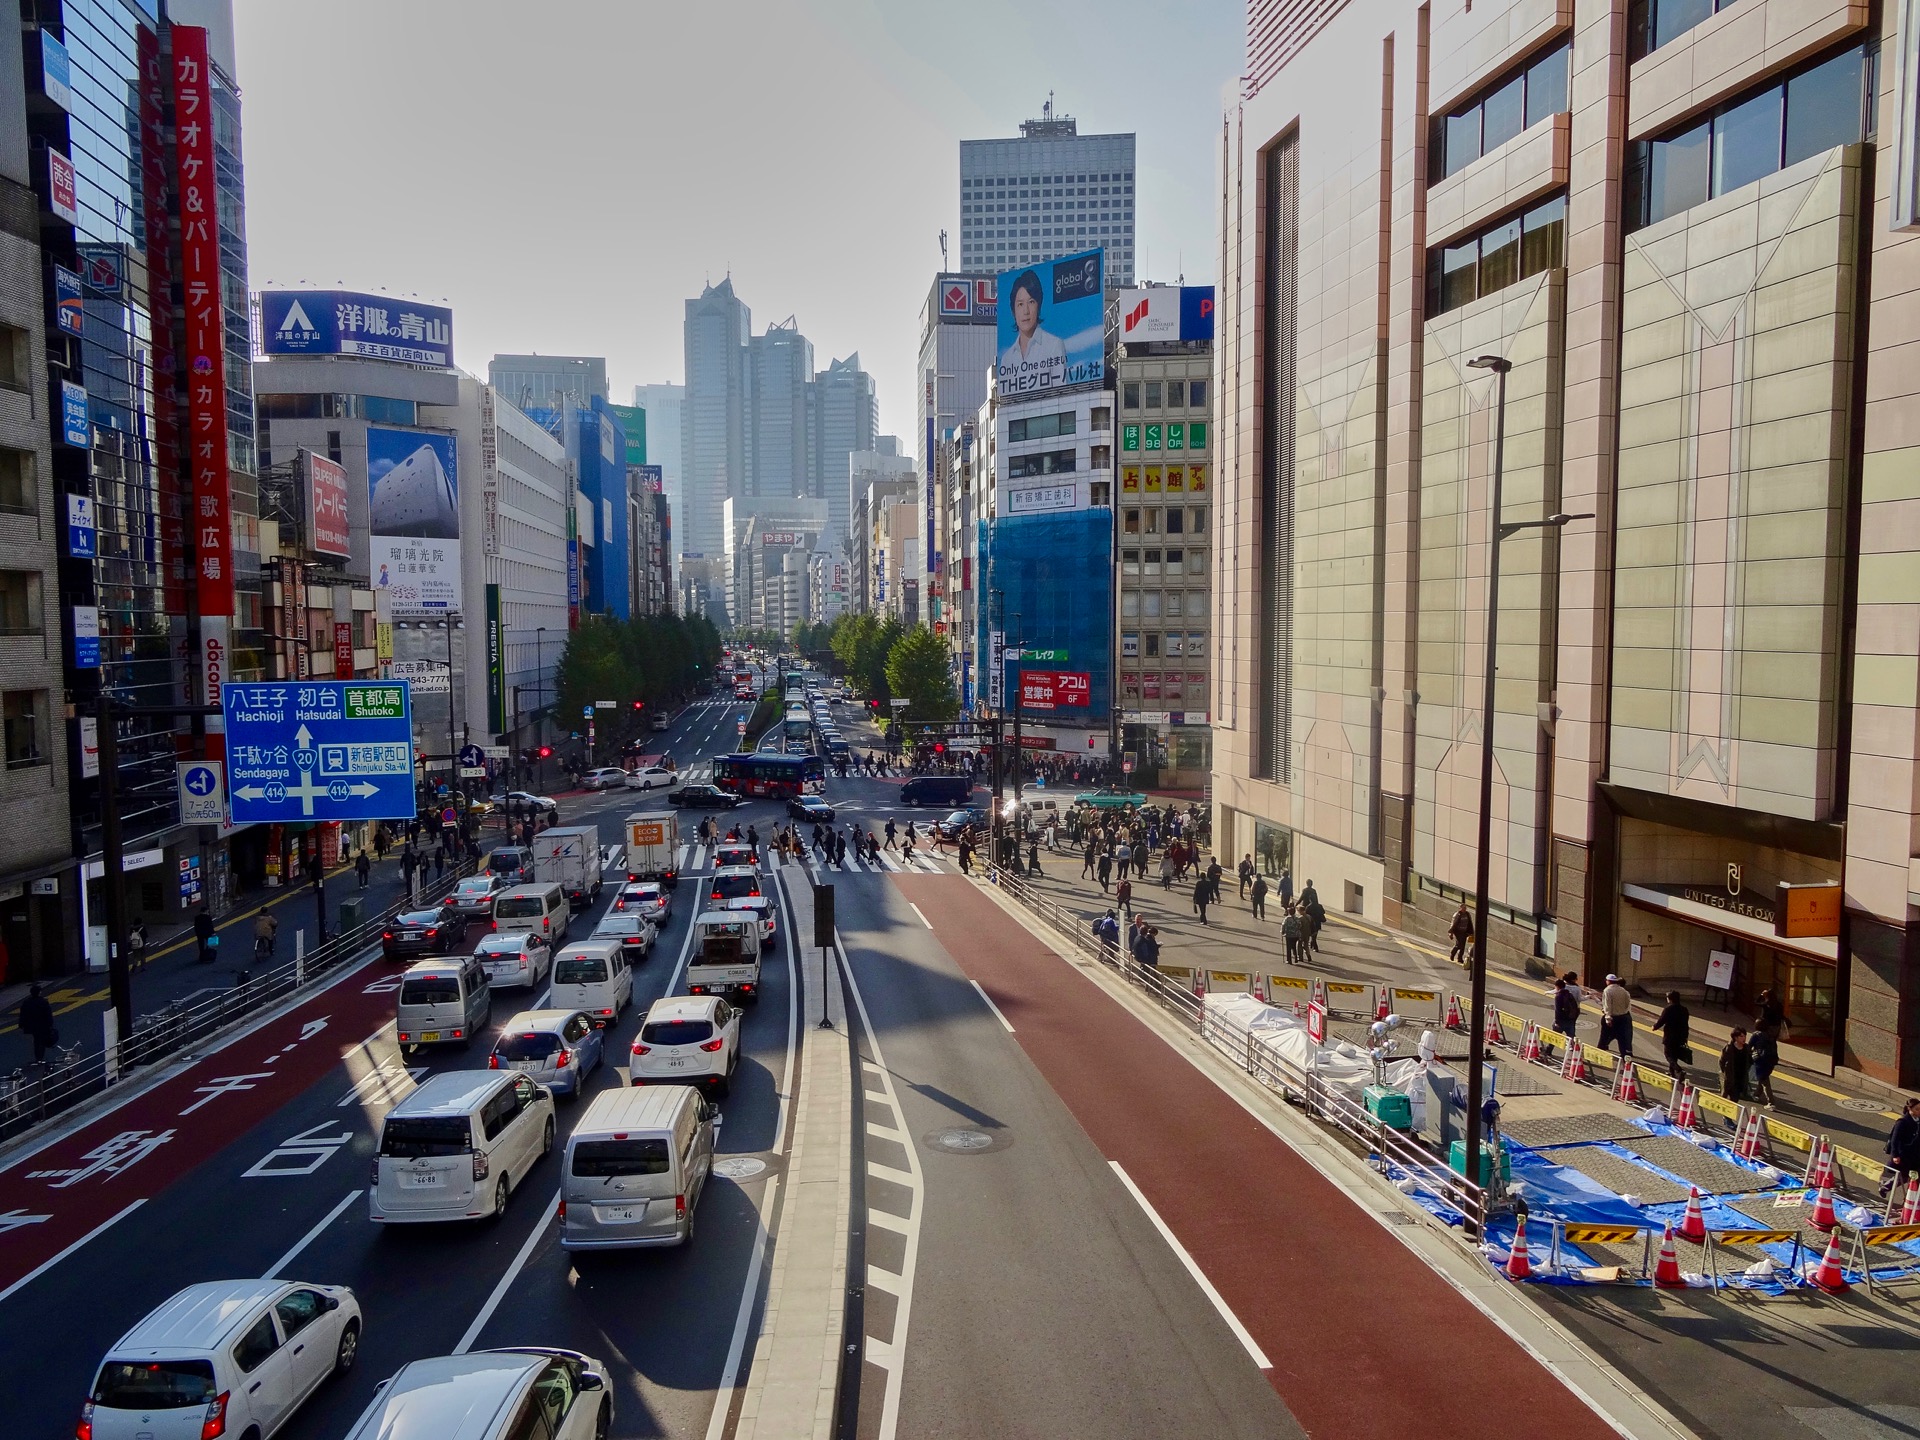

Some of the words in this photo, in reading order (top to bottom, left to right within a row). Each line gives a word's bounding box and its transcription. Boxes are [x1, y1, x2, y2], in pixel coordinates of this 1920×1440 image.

[53, 162, 73, 193] 茜会
[57, 269, 80, 291] 海外旅行
[1055, 270, 1083, 294] global
[335, 303, 449, 345] 洋服の青山
[275, 331, 321, 340] 洋服の青山
[355, 343, 434, 361] 京王百貨店向い
[999, 363, 1019, 377] Only
[1021, 361, 1039, 372] One
[1040, 356, 1068, 369] の住まい
[999, 361, 1100, 394] THEグローバル社
[67, 402, 85, 419] 英会話
[65, 415, 88, 431] イーオン
[1126, 425, 1180, 438] ほぐし
[625, 439, 640, 448] IWA
[196, 385, 221, 580] カラオケ歌広場
[1123, 471, 1183, 489] 占い館
[1015, 488, 1071, 504] 新宿矯正歯科
[764, 533, 793, 543] やまや
[390, 547, 444, 562] 瑠璃光院
[398, 562, 437, 574] 白蓮華堂
[337, 628, 350, 659] 指圧
[1035, 650, 1055, 660] レイク
[394, 662, 446, 674] 広告募集中
[1058, 675, 1087, 689] アコム
[230, 688, 289, 708] 八王子
[297, 688, 338, 708] 初台
[347, 689, 401, 707] 首都高
[1023, 685, 1054, 701] 営業中
[1067, 694, 1079, 703] 6F
[236, 711, 284, 724] Hachioji
[296, 709, 342, 721] Hatsudai
[355, 706, 395, 717] Shutoko
[232, 745, 289, 766] 千駄ヶ谷
[297, 753, 313, 765] 20
[350, 746, 406, 763] 新宿駅西口
[234, 768, 290, 780] Sendagaya
[351, 763, 383, 773] Shinjuku
[266, 788, 283, 798] 414
[330, 785, 348, 796] 414
[189, 800, 216, 809] 7-20
[127, 856, 146, 867] SELECT
[1684, 889, 1725, 908] UNITED
[1730, 902, 1776, 923] ARROW
